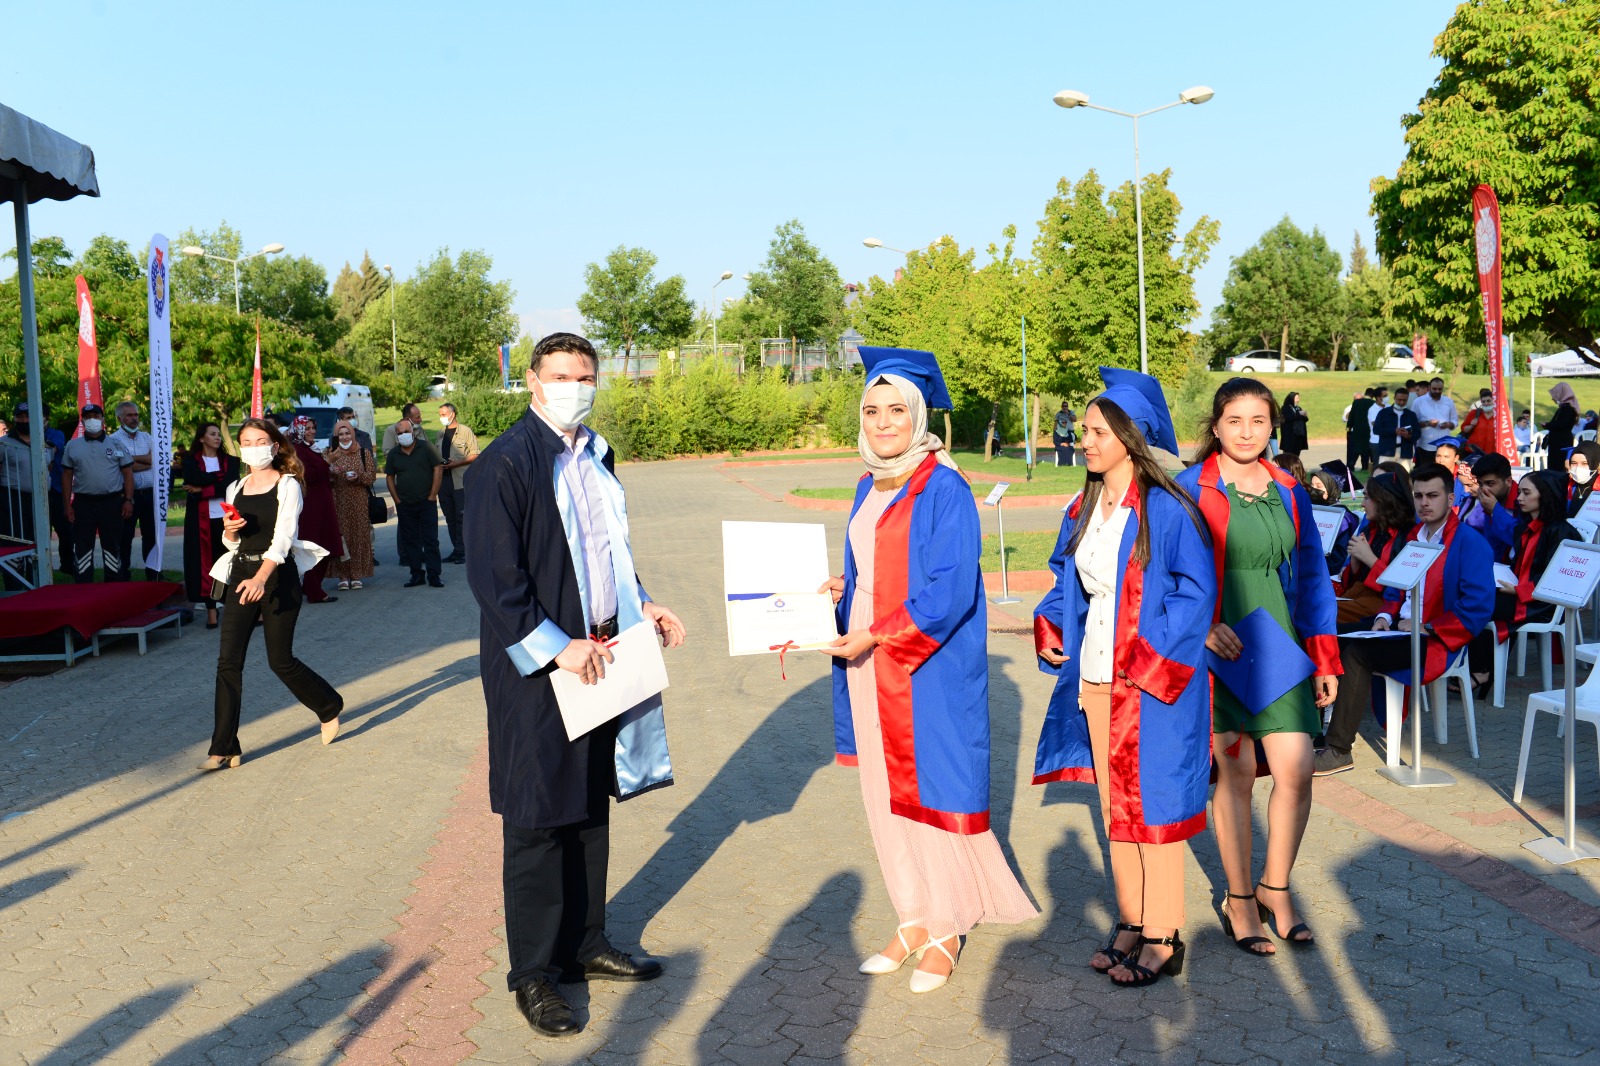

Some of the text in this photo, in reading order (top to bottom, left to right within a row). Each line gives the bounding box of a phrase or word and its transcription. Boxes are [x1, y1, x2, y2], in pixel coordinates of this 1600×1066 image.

[1503, 438, 1516, 465] TÇÜ
[1568, 554, 1590, 566] ZİRAAT
[1558, 567, 1588, 579] FAKÜLTESİ
